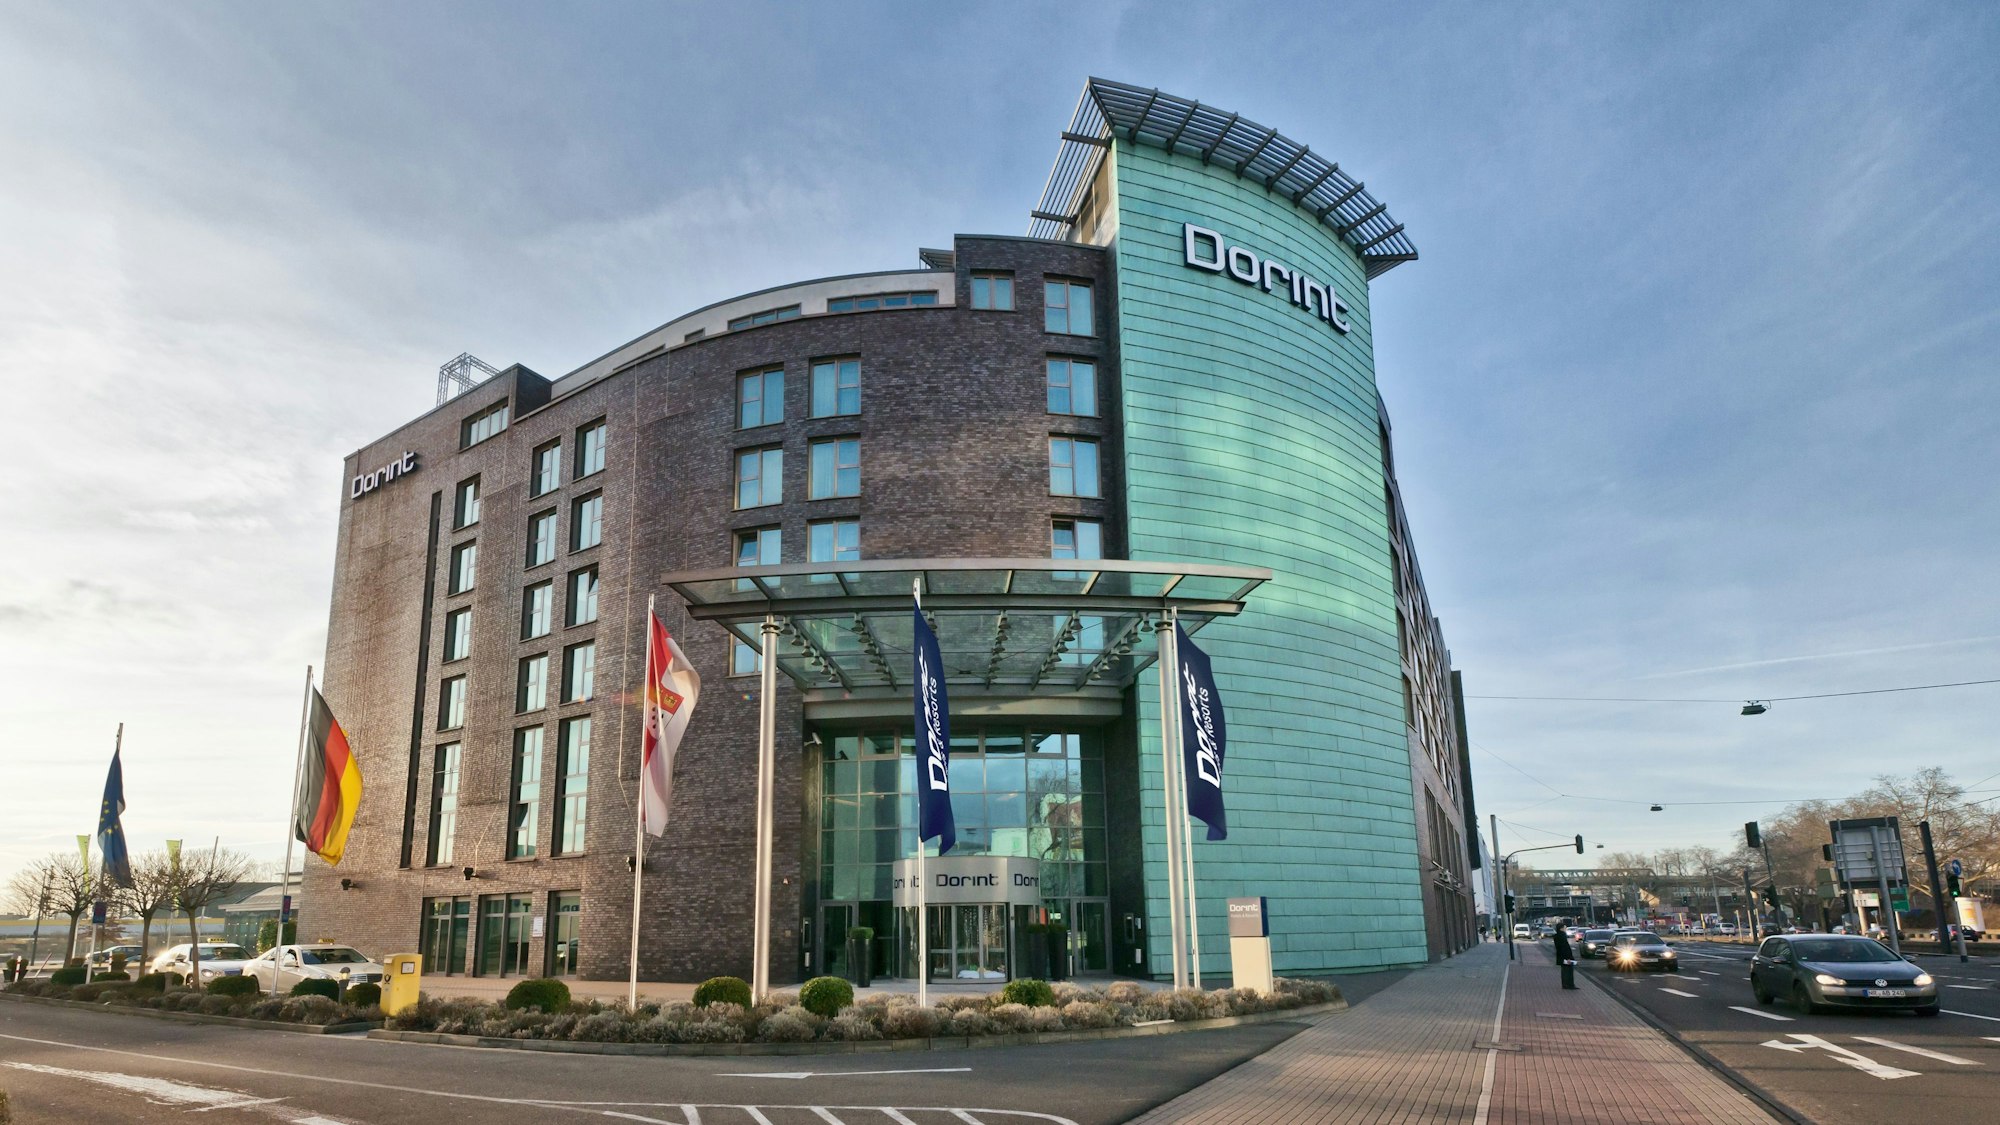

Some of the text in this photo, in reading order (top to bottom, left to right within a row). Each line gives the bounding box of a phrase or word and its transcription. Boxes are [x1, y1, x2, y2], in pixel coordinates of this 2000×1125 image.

[1183, 222, 1350, 335] Dorint
[351, 450, 415, 499] Dorint
[929, 676, 942, 736] Resorts
[1198, 687, 1215, 739] Resorts
[935, 873, 999, 887] Dorint
[1229, 903, 1259, 912] Dorint
